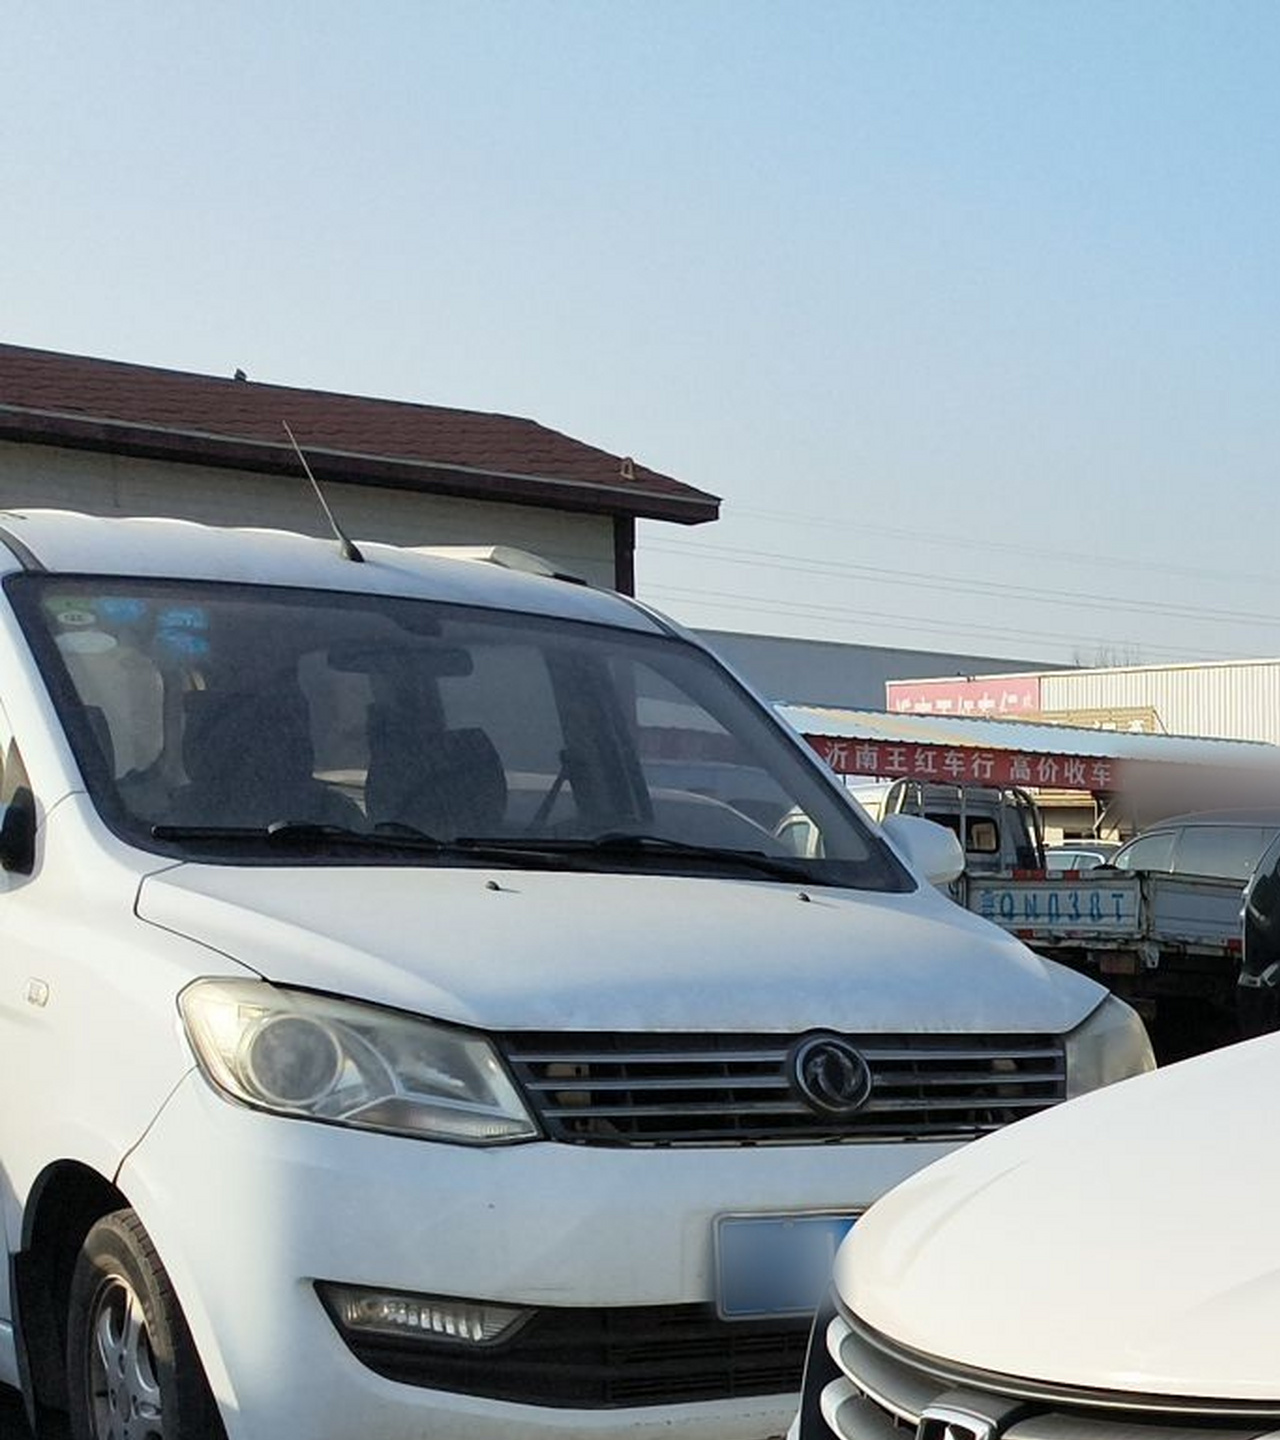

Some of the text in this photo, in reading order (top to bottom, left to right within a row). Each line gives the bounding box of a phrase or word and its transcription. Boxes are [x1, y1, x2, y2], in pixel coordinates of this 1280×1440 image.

[824, 741, 1112, 786] 沂南王红车行 高价收车
